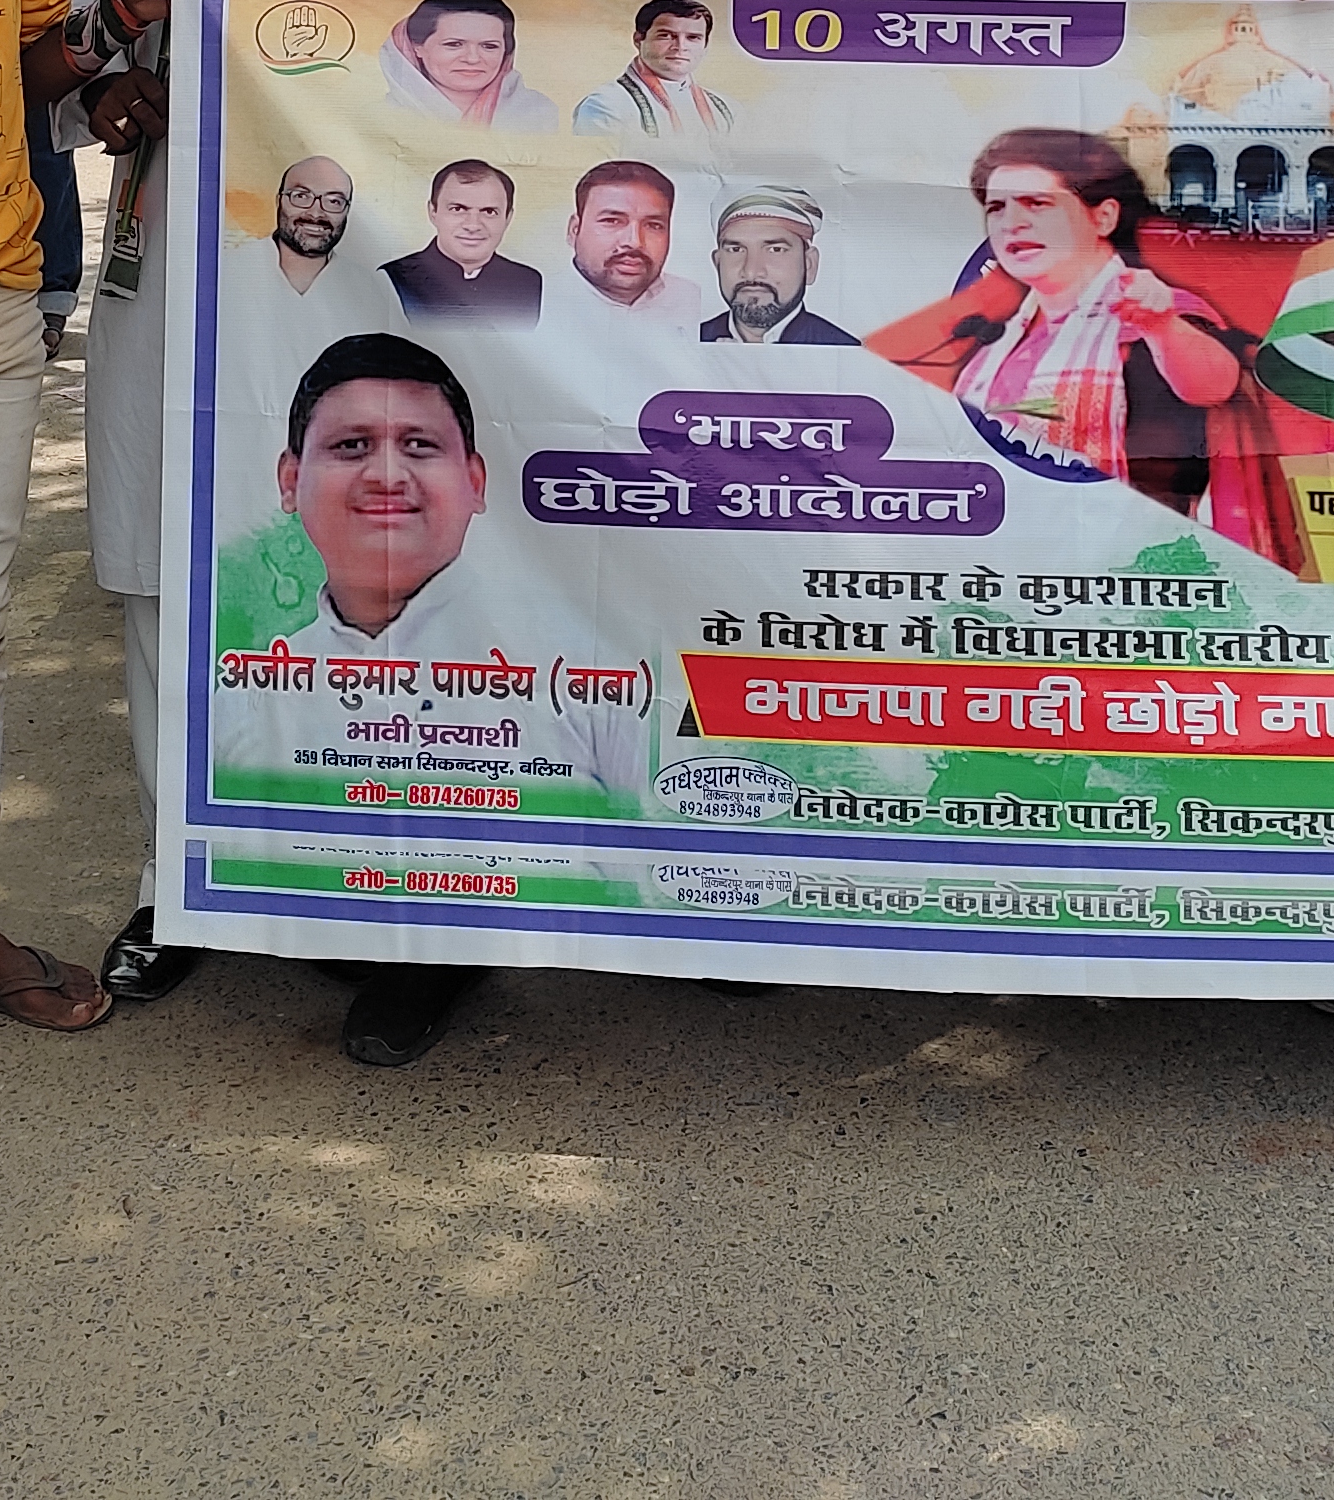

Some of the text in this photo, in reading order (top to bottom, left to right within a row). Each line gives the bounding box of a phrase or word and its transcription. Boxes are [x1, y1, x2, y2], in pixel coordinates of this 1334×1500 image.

[750, 9, 1072, 57] 10 अगस्त
[533, 468, 697, 522] छोड़ो
[802, 566, 1228, 617] सरकार के कुप्रशासन
[701, 611, 1331, 665] के विरोध में विधानसभा स्तरीय
[219, 636, 655, 720] अजीत कुमार पाण्डेय (बाबा)
[744, 678, 948, 727] भाजपा
[964, 676, 1085, 738] गद्दी
[1105, 679, 1240, 745] छोड़ो
[346, 714, 521, 748] भावी प्रत्याशी
[294, 748, 573, 780] 359 विधान सभा सिकन्दरपुर, बलिया
[659, 764, 740, 795] राधेश्याम
[408, 785, 519, 808] 8874260735
[679, 801, 761, 818] 8924893948
[767, 789, 776, 803] के
[778, 792, 793, 805] पास
[1068, 799, 1167, 837] पार्टी,
[406, 871, 516, 896] 8874260735
[678, 888, 760, 906] 8924893948
[1068, 888, 1167, 925] पार्टी,
